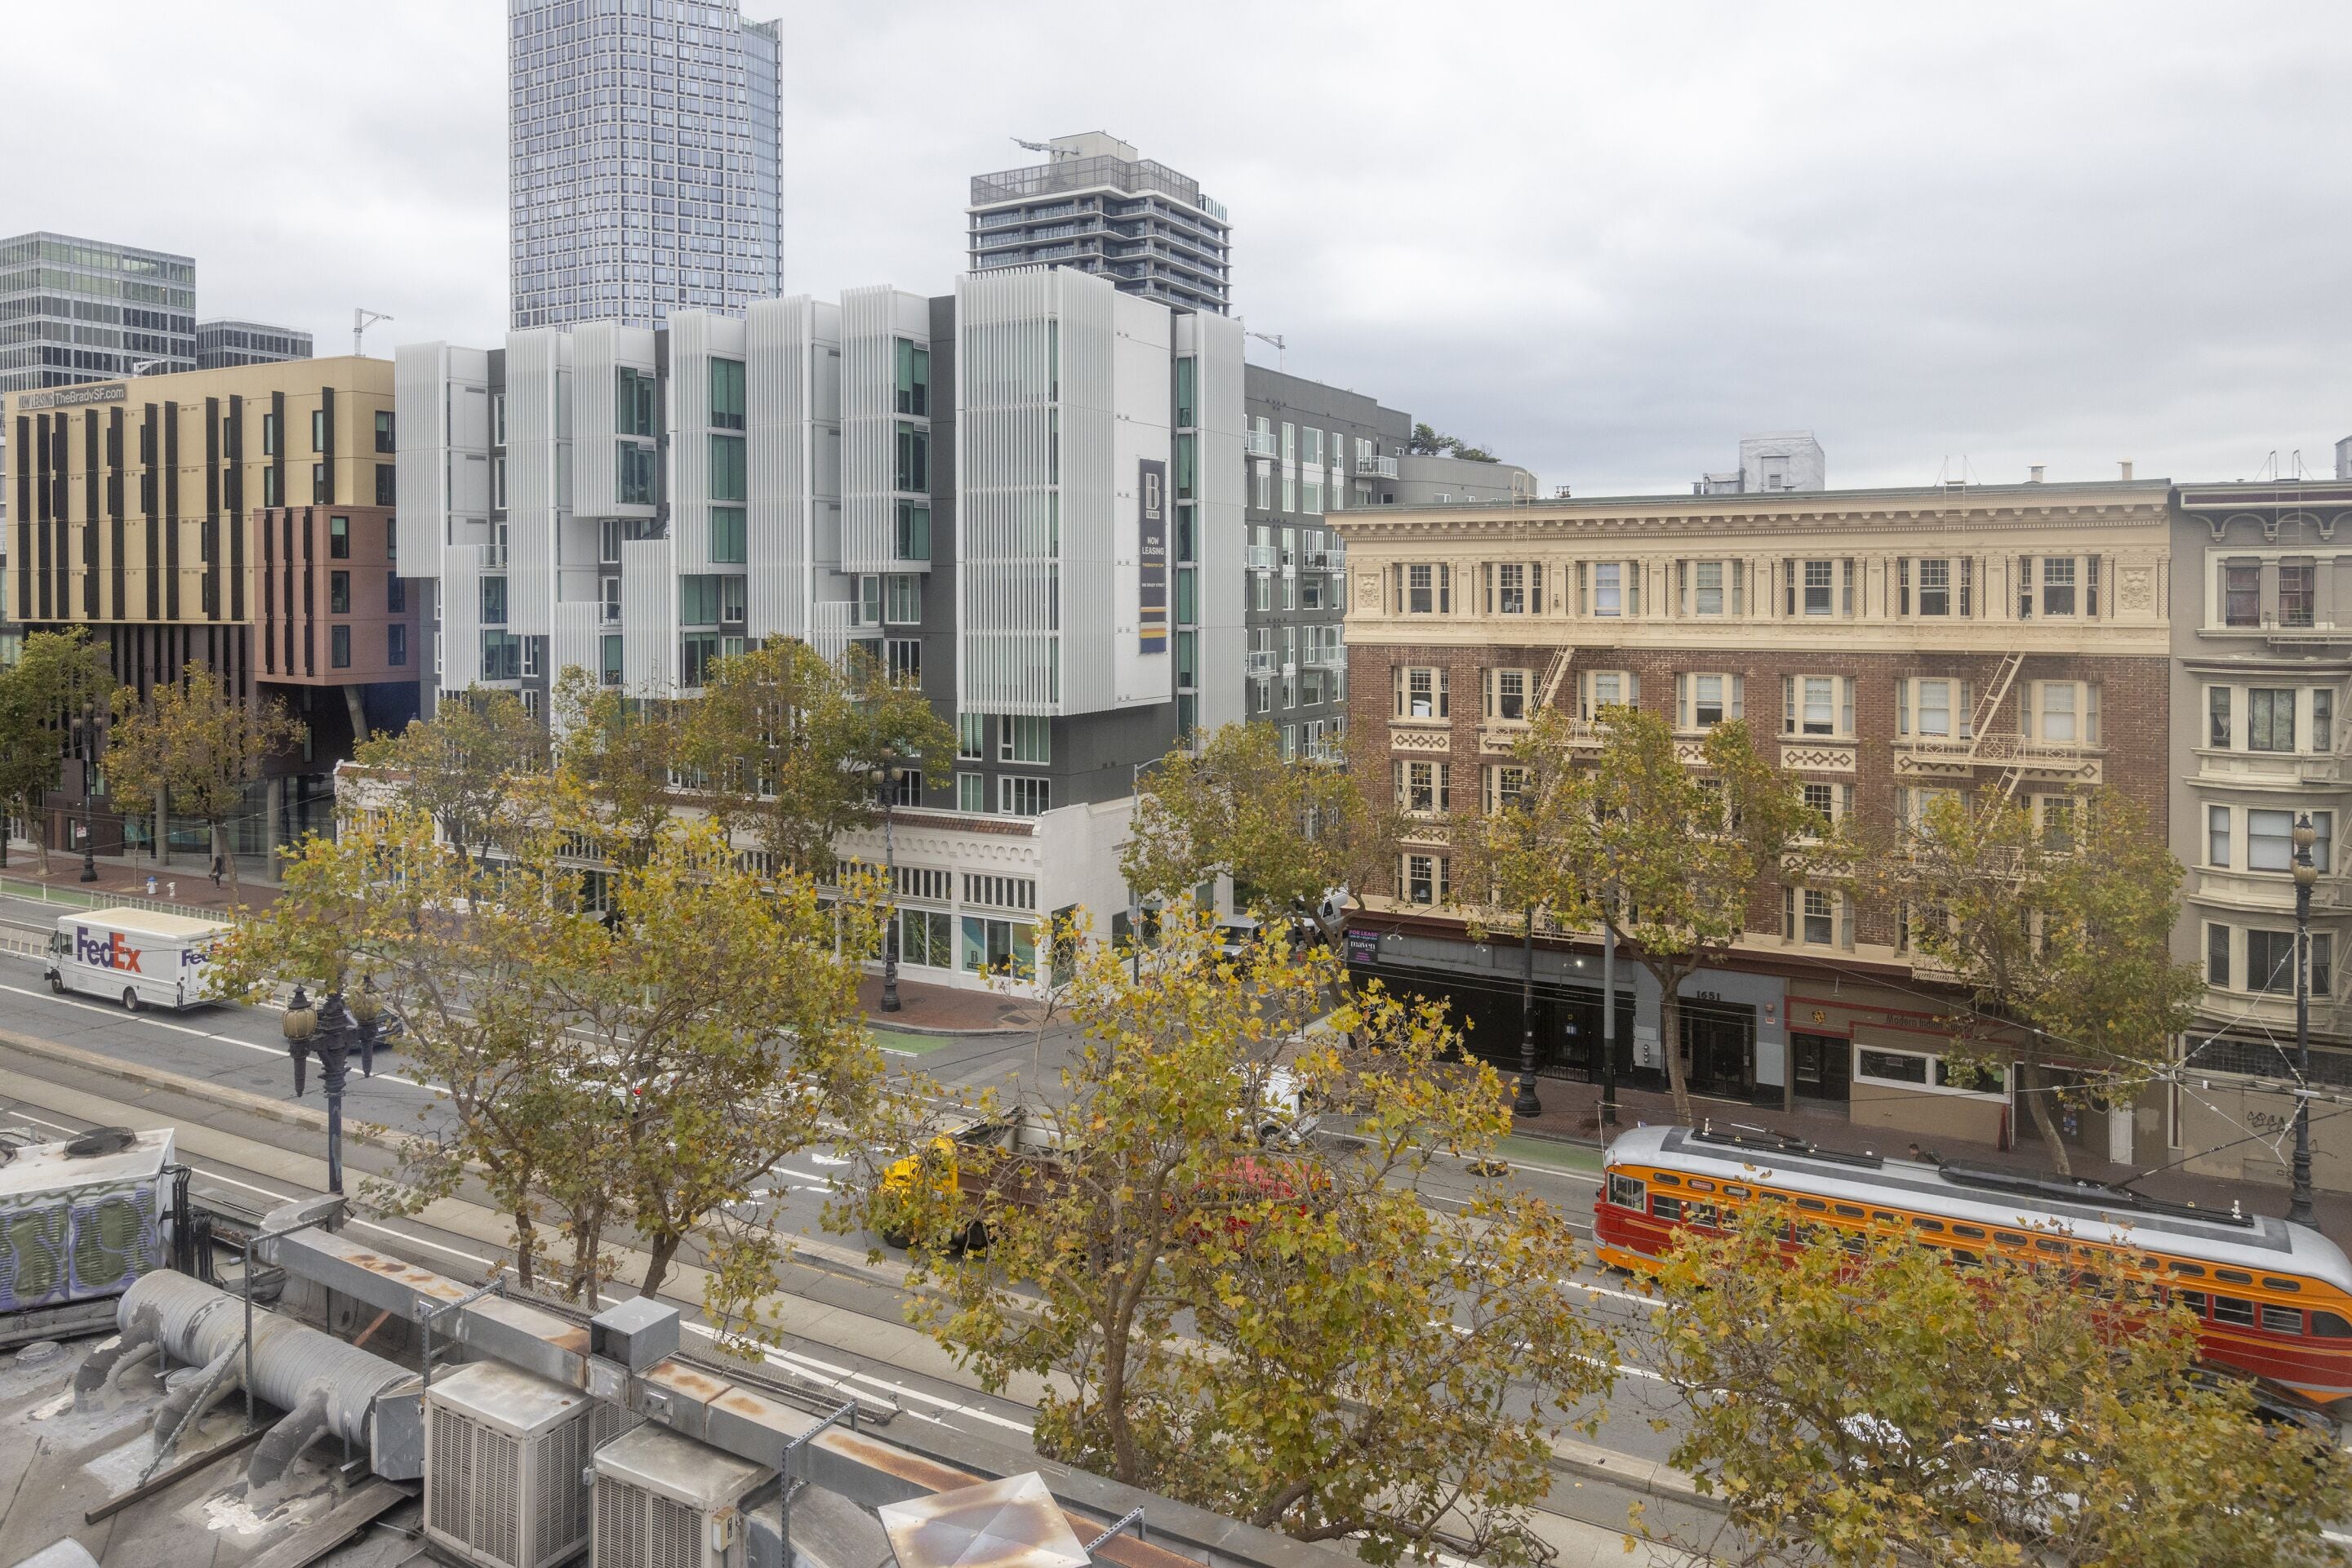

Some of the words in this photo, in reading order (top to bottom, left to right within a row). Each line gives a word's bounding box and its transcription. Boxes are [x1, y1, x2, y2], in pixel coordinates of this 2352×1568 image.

[19, 393, 30, 409] NOW
[32, 391, 53, 408] LEASING
[55, 388, 124, 405] TheBradySF.com
[1147, 536, 1159, 545] NOW
[1141, 546, 1164, 555] LEASING
[77, 925, 143, 974] FedEx
[1350, 941, 1376, 949] maven
[1696, 990, 1720, 1000] 1651
[1886, 1013, 1918, 1027] Modern
[1919, 1018, 1943, 1029] Indian
